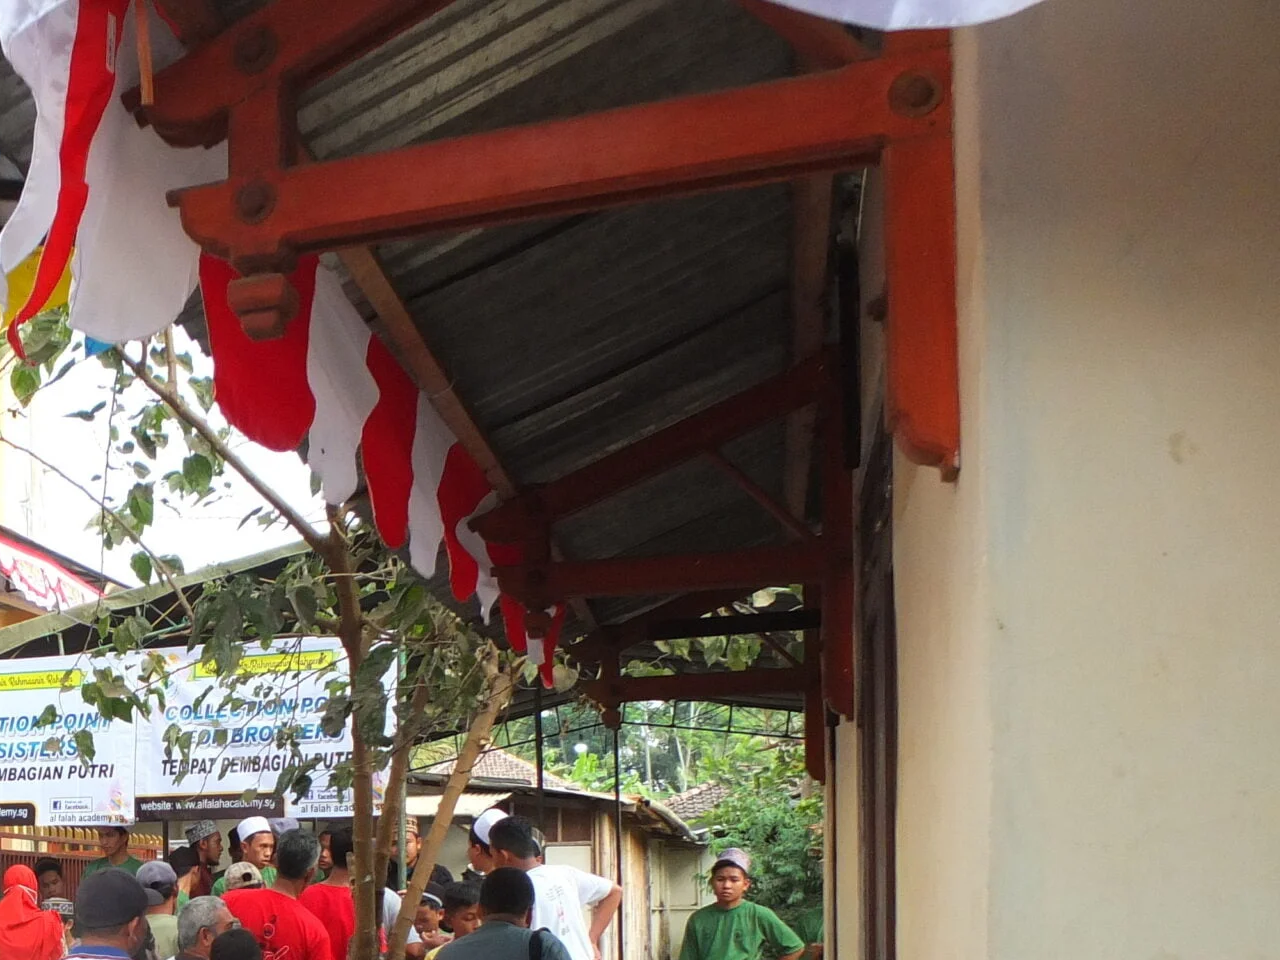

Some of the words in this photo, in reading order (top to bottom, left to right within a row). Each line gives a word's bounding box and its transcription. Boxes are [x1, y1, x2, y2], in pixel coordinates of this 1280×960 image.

[68, 763, 115, 779] PUTRI
[140, 800, 173, 811] website:
[301, 804, 308, 813] al
[310, 803, 331, 813] falah
[50, 814, 57, 822] al
[58, 814, 77, 822] falah
[79, 813, 112, 823] academy
